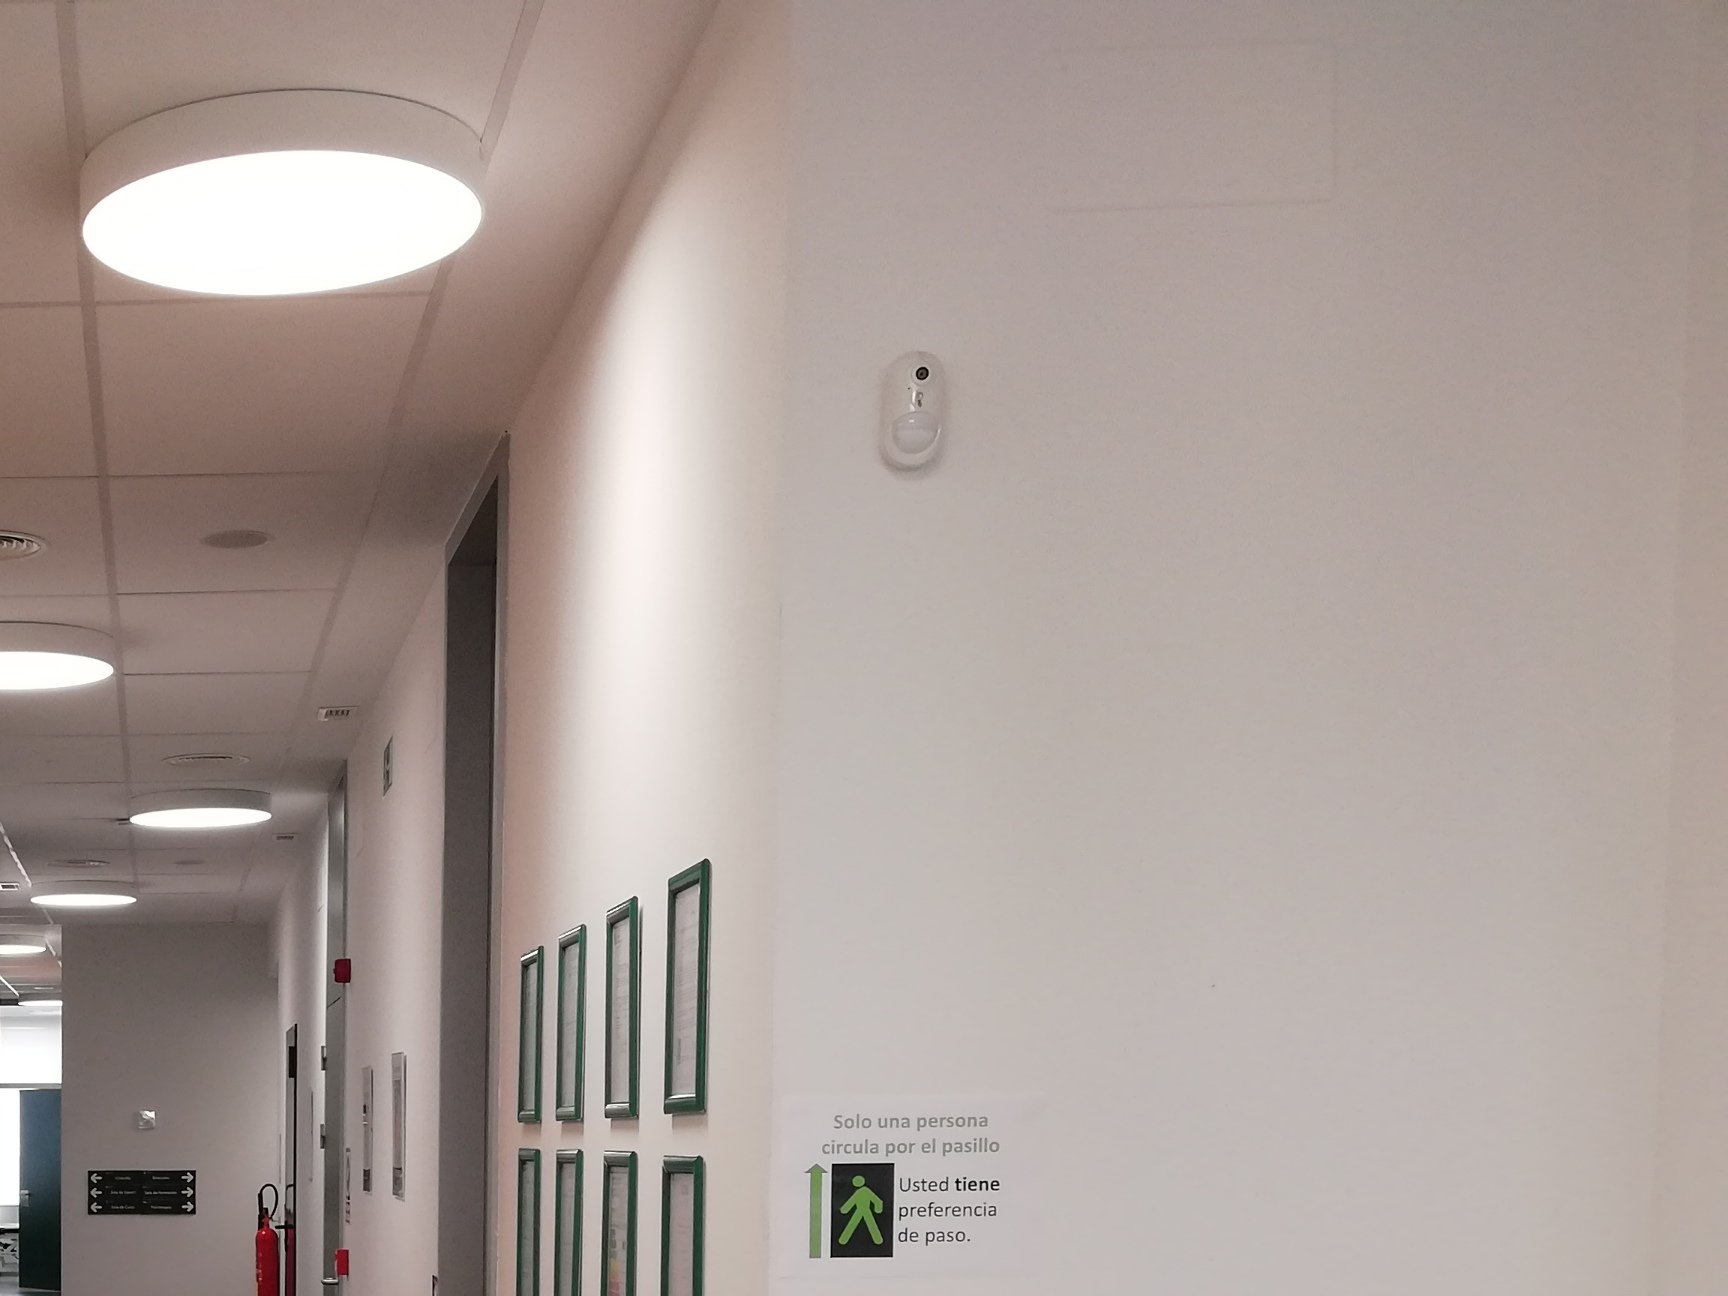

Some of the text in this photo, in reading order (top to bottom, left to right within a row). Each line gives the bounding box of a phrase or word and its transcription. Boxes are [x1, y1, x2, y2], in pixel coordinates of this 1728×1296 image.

[833, 1113, 989, 1132] Solo una persona
[821, 1137, 1001, 1157] circula por el pasillo
[898, 1176, 1001, 1193] Usted tiene
[898, 1200, 998, 1221] preferencia
[897, 1227, 972, 1246] de paso.
